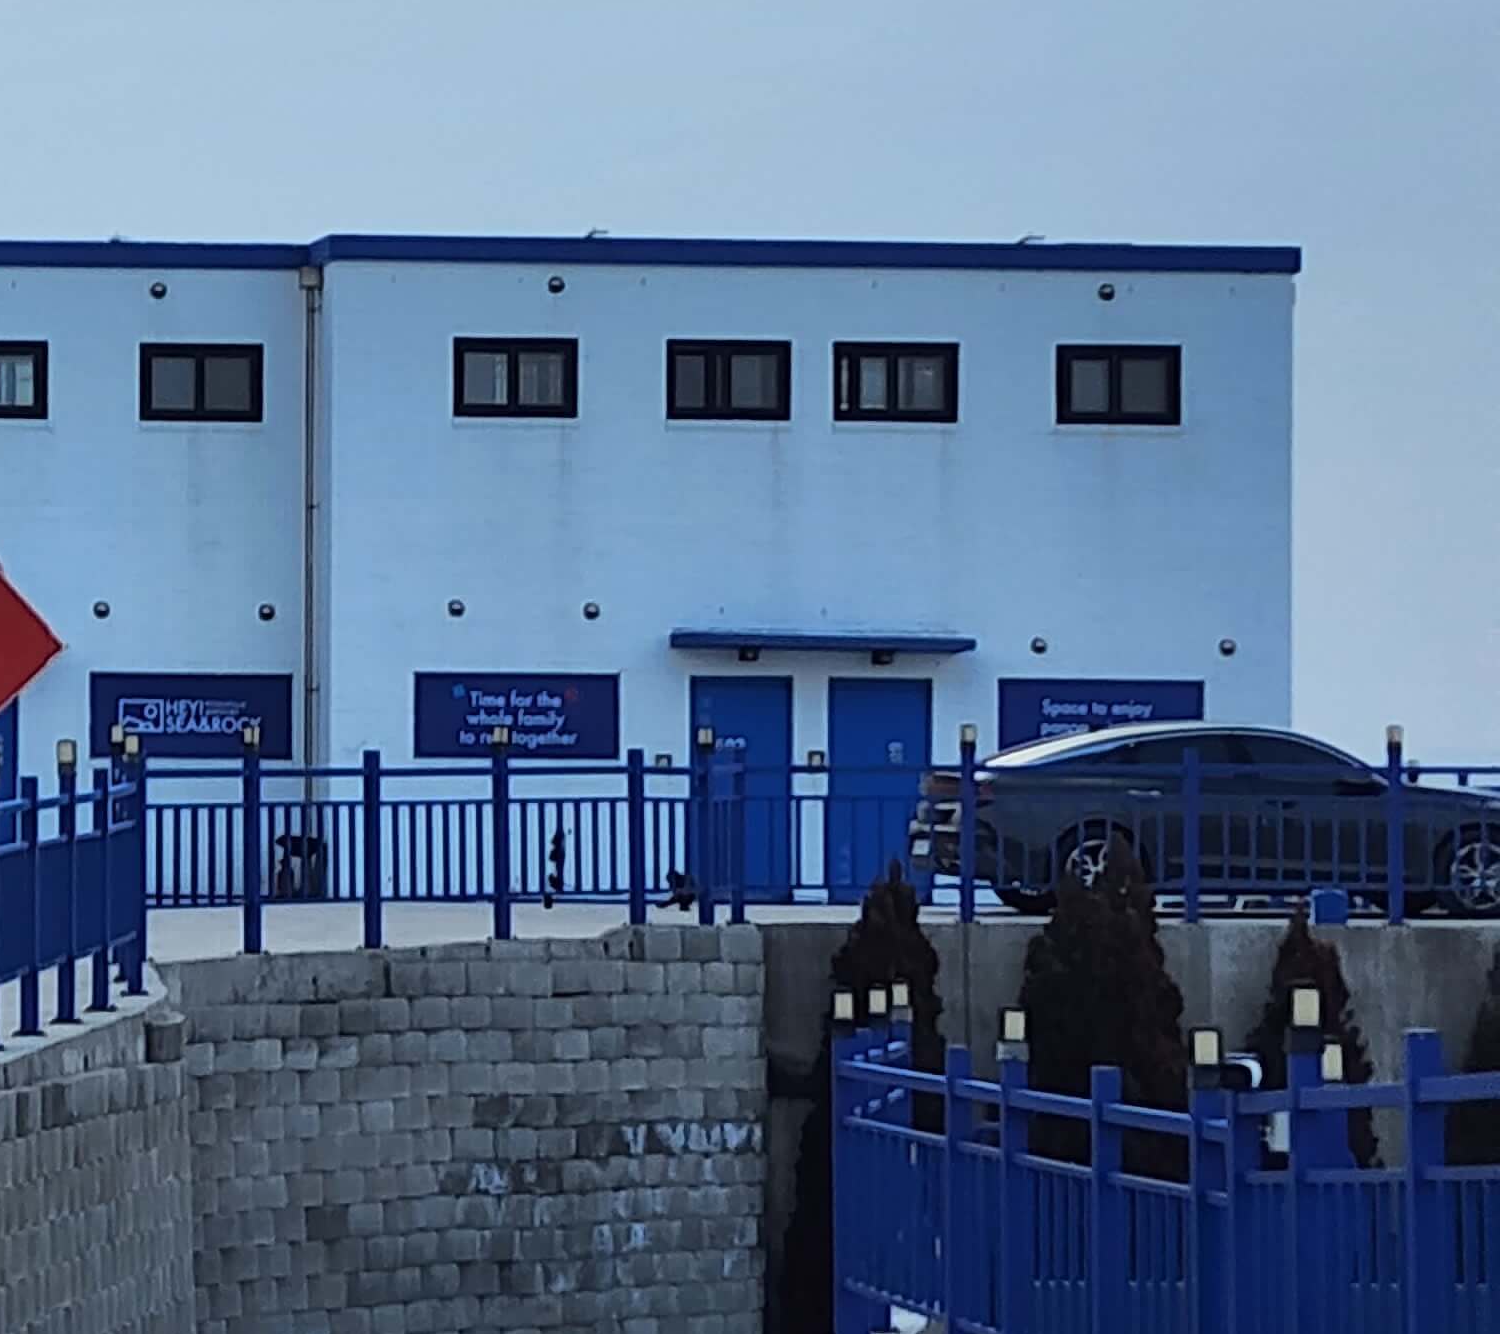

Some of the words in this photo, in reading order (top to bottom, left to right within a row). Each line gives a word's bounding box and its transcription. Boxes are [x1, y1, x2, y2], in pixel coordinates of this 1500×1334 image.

[469, 690, 506, 708] Time
[510, 688, 532, 708] for
[536, 690, 563, 708] the
[1041, 698, 1089, 718] Space
[465, 708, 514, 726] whole
[517, 708, 566, 731] family
[459, 730, 476, 745] to
[511, 730, 579, 749] together
